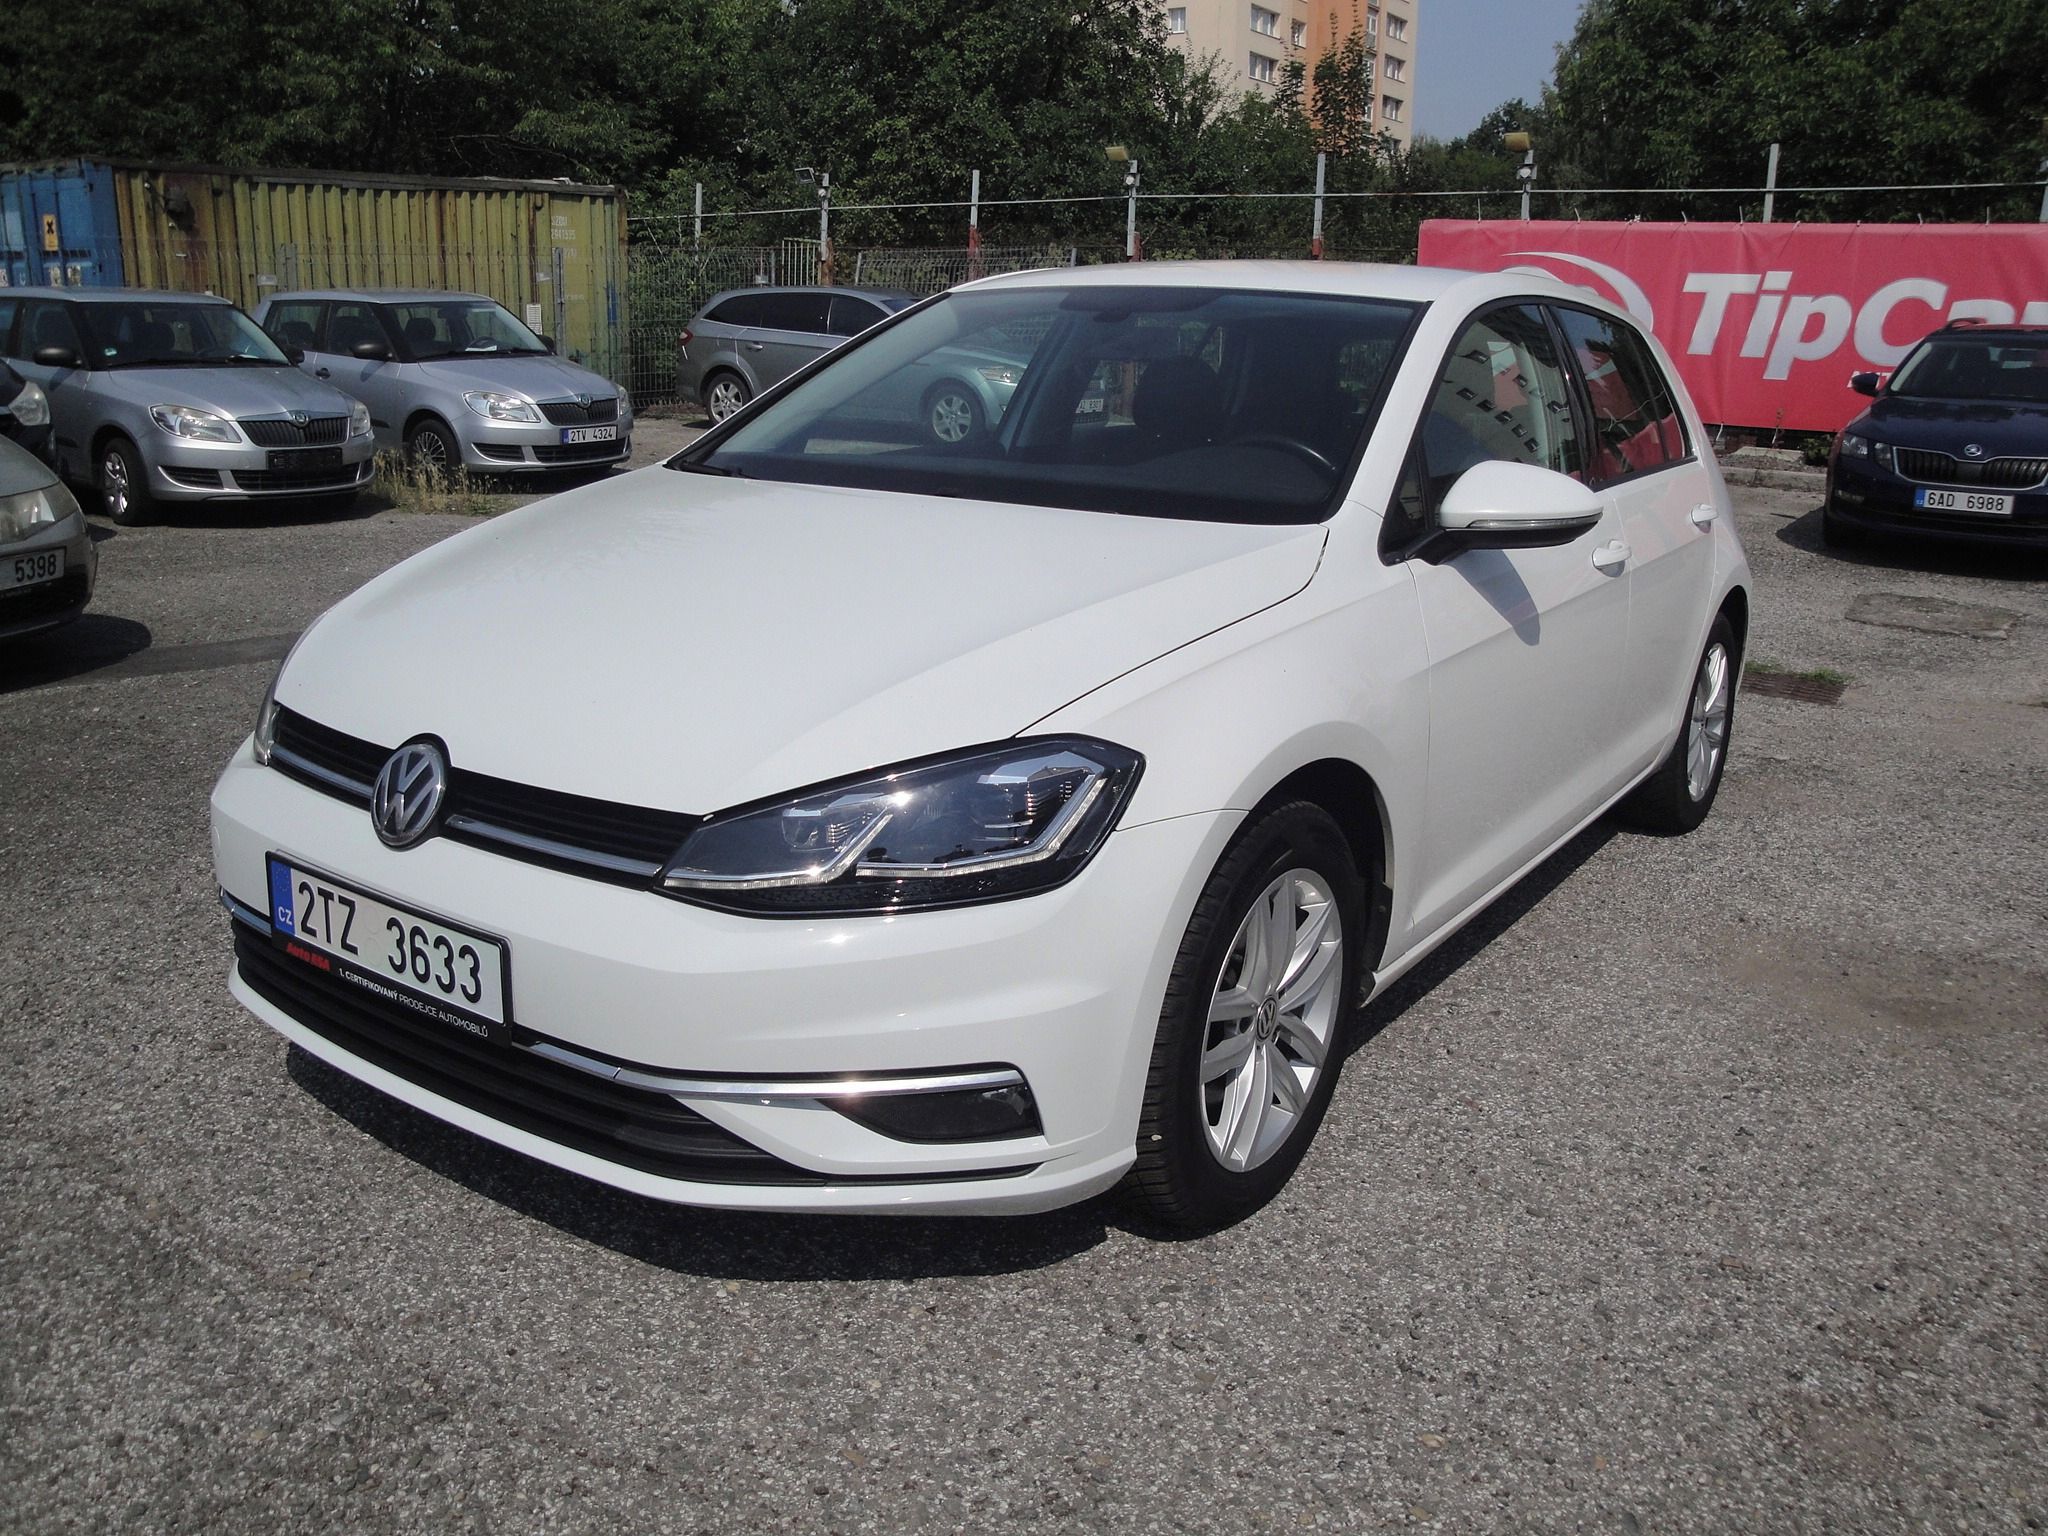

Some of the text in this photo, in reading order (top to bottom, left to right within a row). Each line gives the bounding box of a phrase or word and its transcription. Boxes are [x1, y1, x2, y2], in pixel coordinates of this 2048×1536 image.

[571, 430, 586, 441] 2TV
[593, 428, 613, 439] 4324
[1928, 492, 2004, 511] 6AD 6988
[15, 554, 56, 582] 5398
[278, 906, 292, 925] CZ
[298, 881, 482, 1004] 2TZ 3633
[345, 971, 399, 1000] CERTIFIKOVANÝ
[399, 994, 437, 1018] PRODEJCE
[438, 1011, 488, 1038] AUTOMOBILŮ
